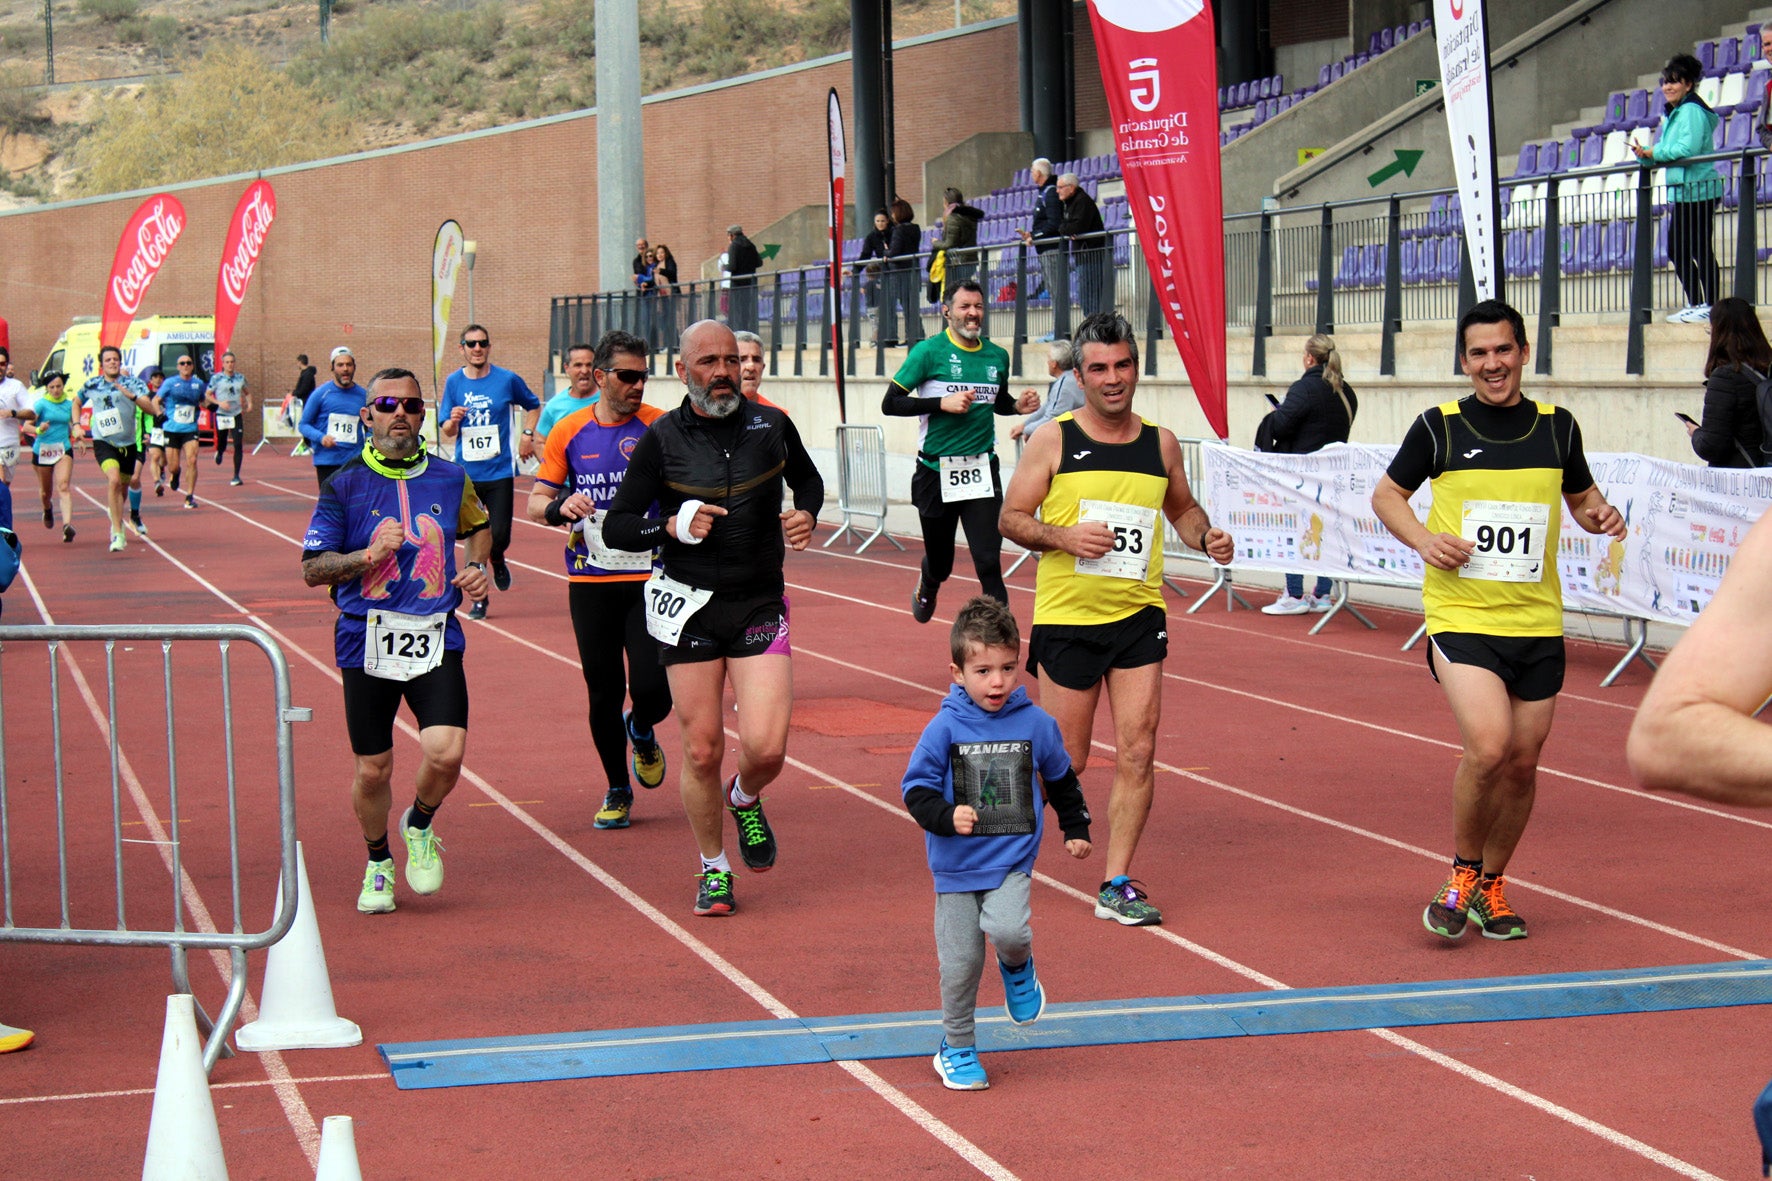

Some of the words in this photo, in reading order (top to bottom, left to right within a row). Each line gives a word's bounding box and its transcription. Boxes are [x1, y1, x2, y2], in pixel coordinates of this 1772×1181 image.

[166, 332, 214, 340] AMBULANCI
[334, 423, 353, 433] 118
[469, 437, 492, 449] 167
[576, 473, 606, 485] ONA
[950, 469, 982, 486] 588
[1112, 526, 1143, 554] 53
[1476, 524, 1531, 555] 901
[651, 587, 686, 619] 780
[381, 632, 430, 659] 123
